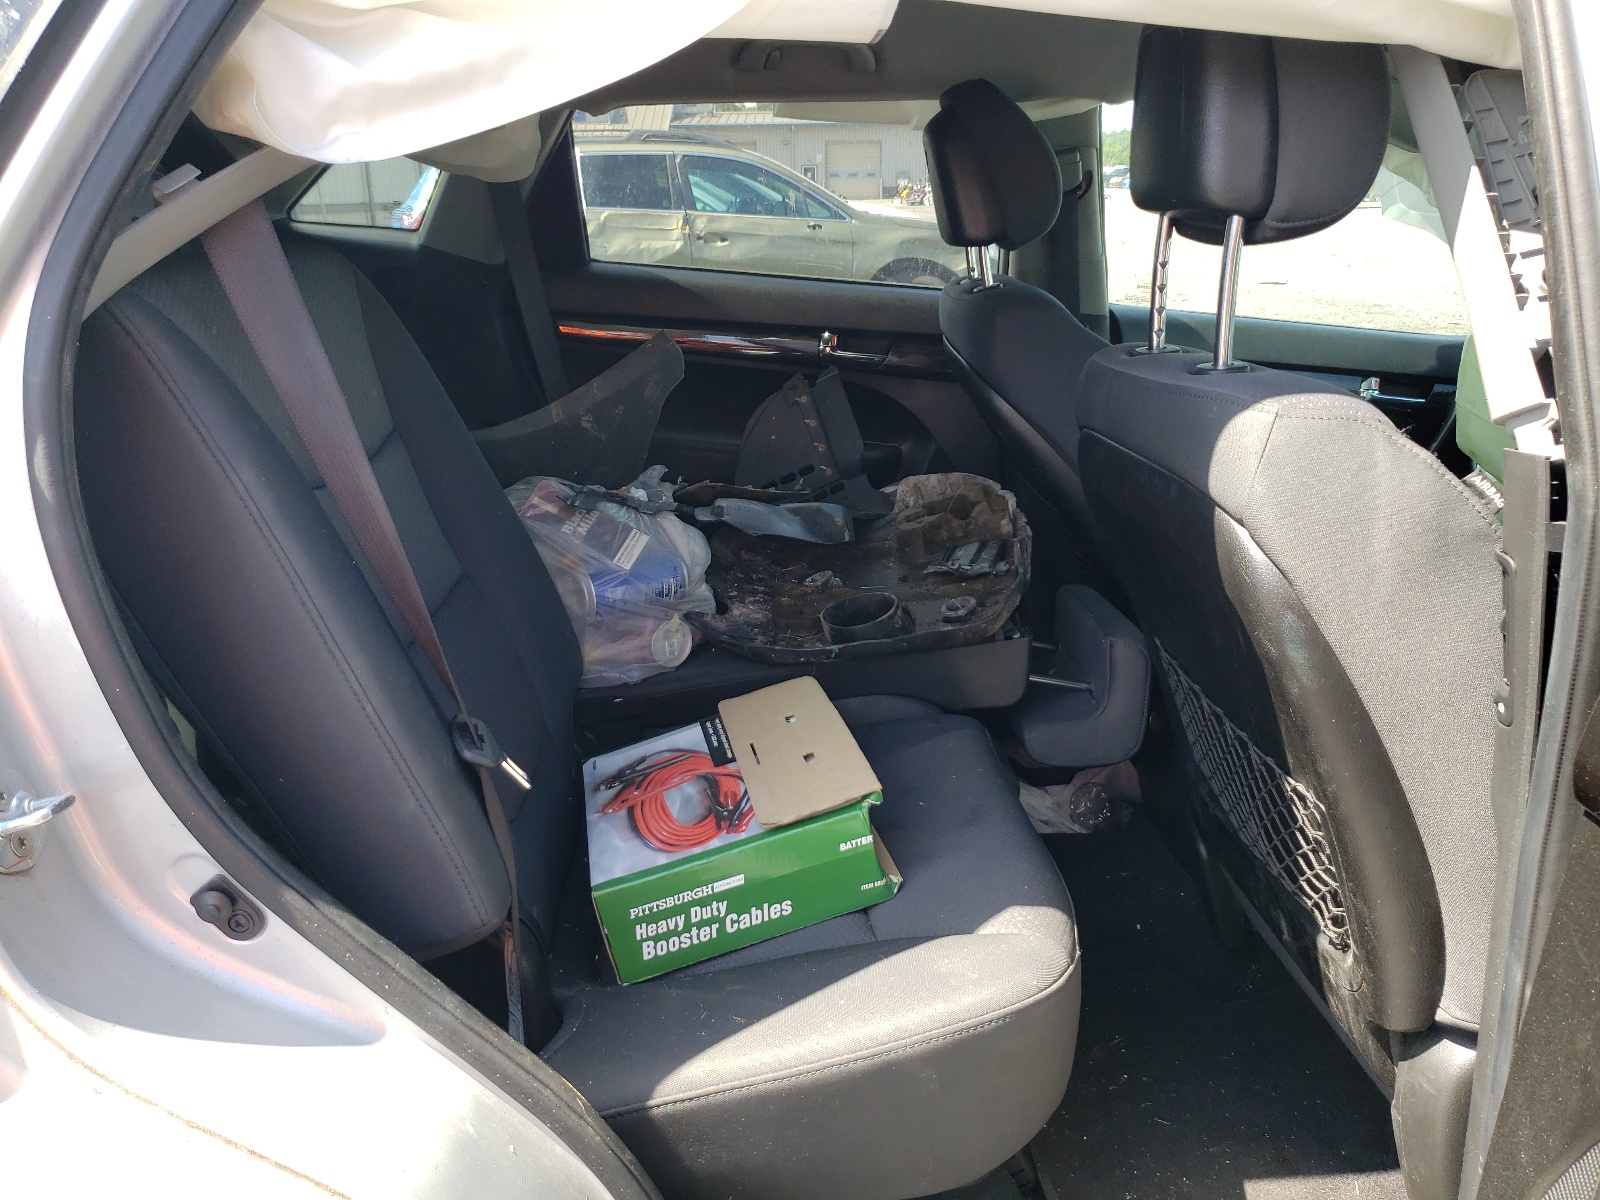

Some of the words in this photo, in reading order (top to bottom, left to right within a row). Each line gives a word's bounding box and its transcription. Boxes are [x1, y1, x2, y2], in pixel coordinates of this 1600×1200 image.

[1470, 475, 1504, 508] AIRBAG
[560, 508, 586, 534] Blac
[839, 834, 874, 851] BATTER
[629, 883, 714, 919] PITTSBURGH
[635, 912, 686, 941] Heavy
[690, 900, 728, 923] Duty
[642, 921, 720, 961] Booster
[725, 899, 793, 934] Cables
